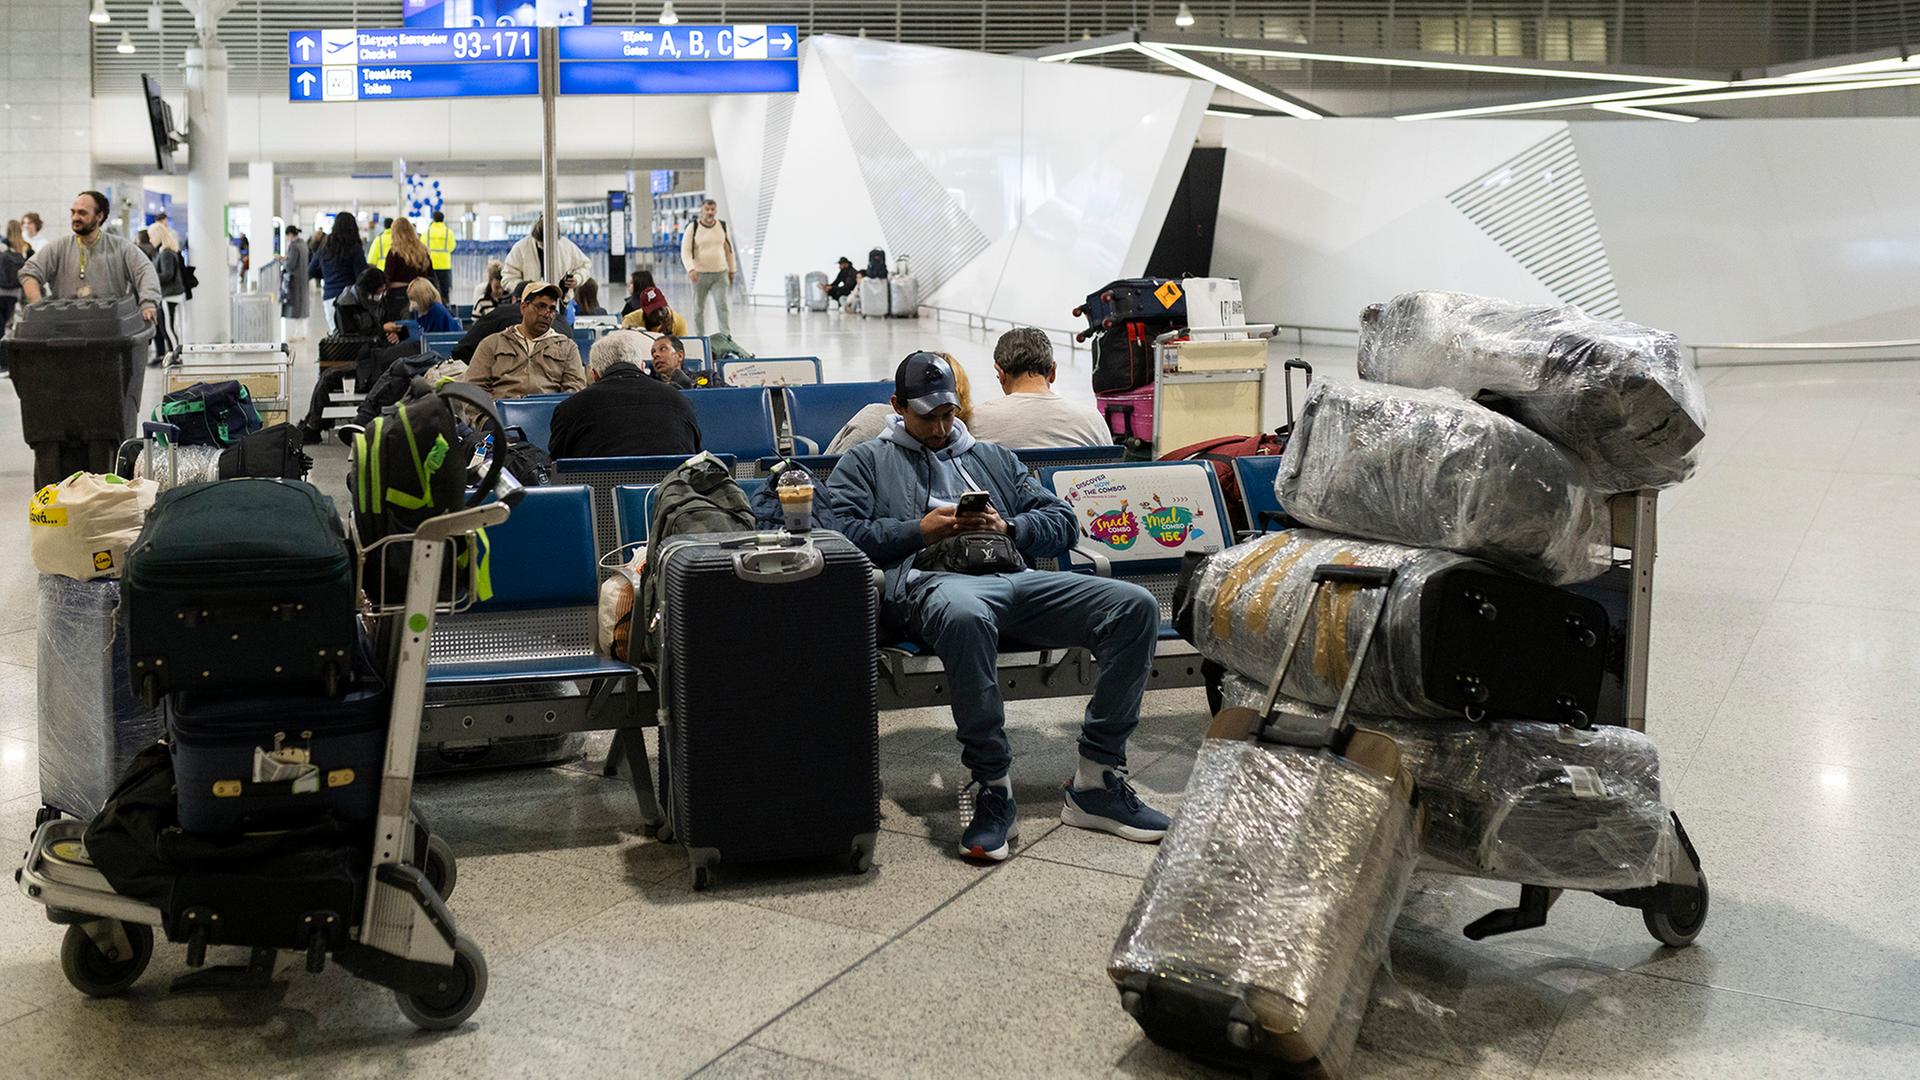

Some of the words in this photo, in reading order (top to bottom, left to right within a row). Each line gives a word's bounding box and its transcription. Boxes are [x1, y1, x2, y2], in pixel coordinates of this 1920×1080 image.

[453, 31, 531, 58] 93-171
[658, 30, 681, 59] A,
[689, 30, 710, 59] B,
[717, 30, 733, 56] C
[1076, 474, 1106, 489] DISCOVER
[1098, 485, 1126, 493] COMBOS
[1096, 512, 1130, 532] Snack
[1145, 506, 1180, 528] Meal
[1111, 534, 1129, 545] 9€
[1160, 531, 1181, 542] 15€
